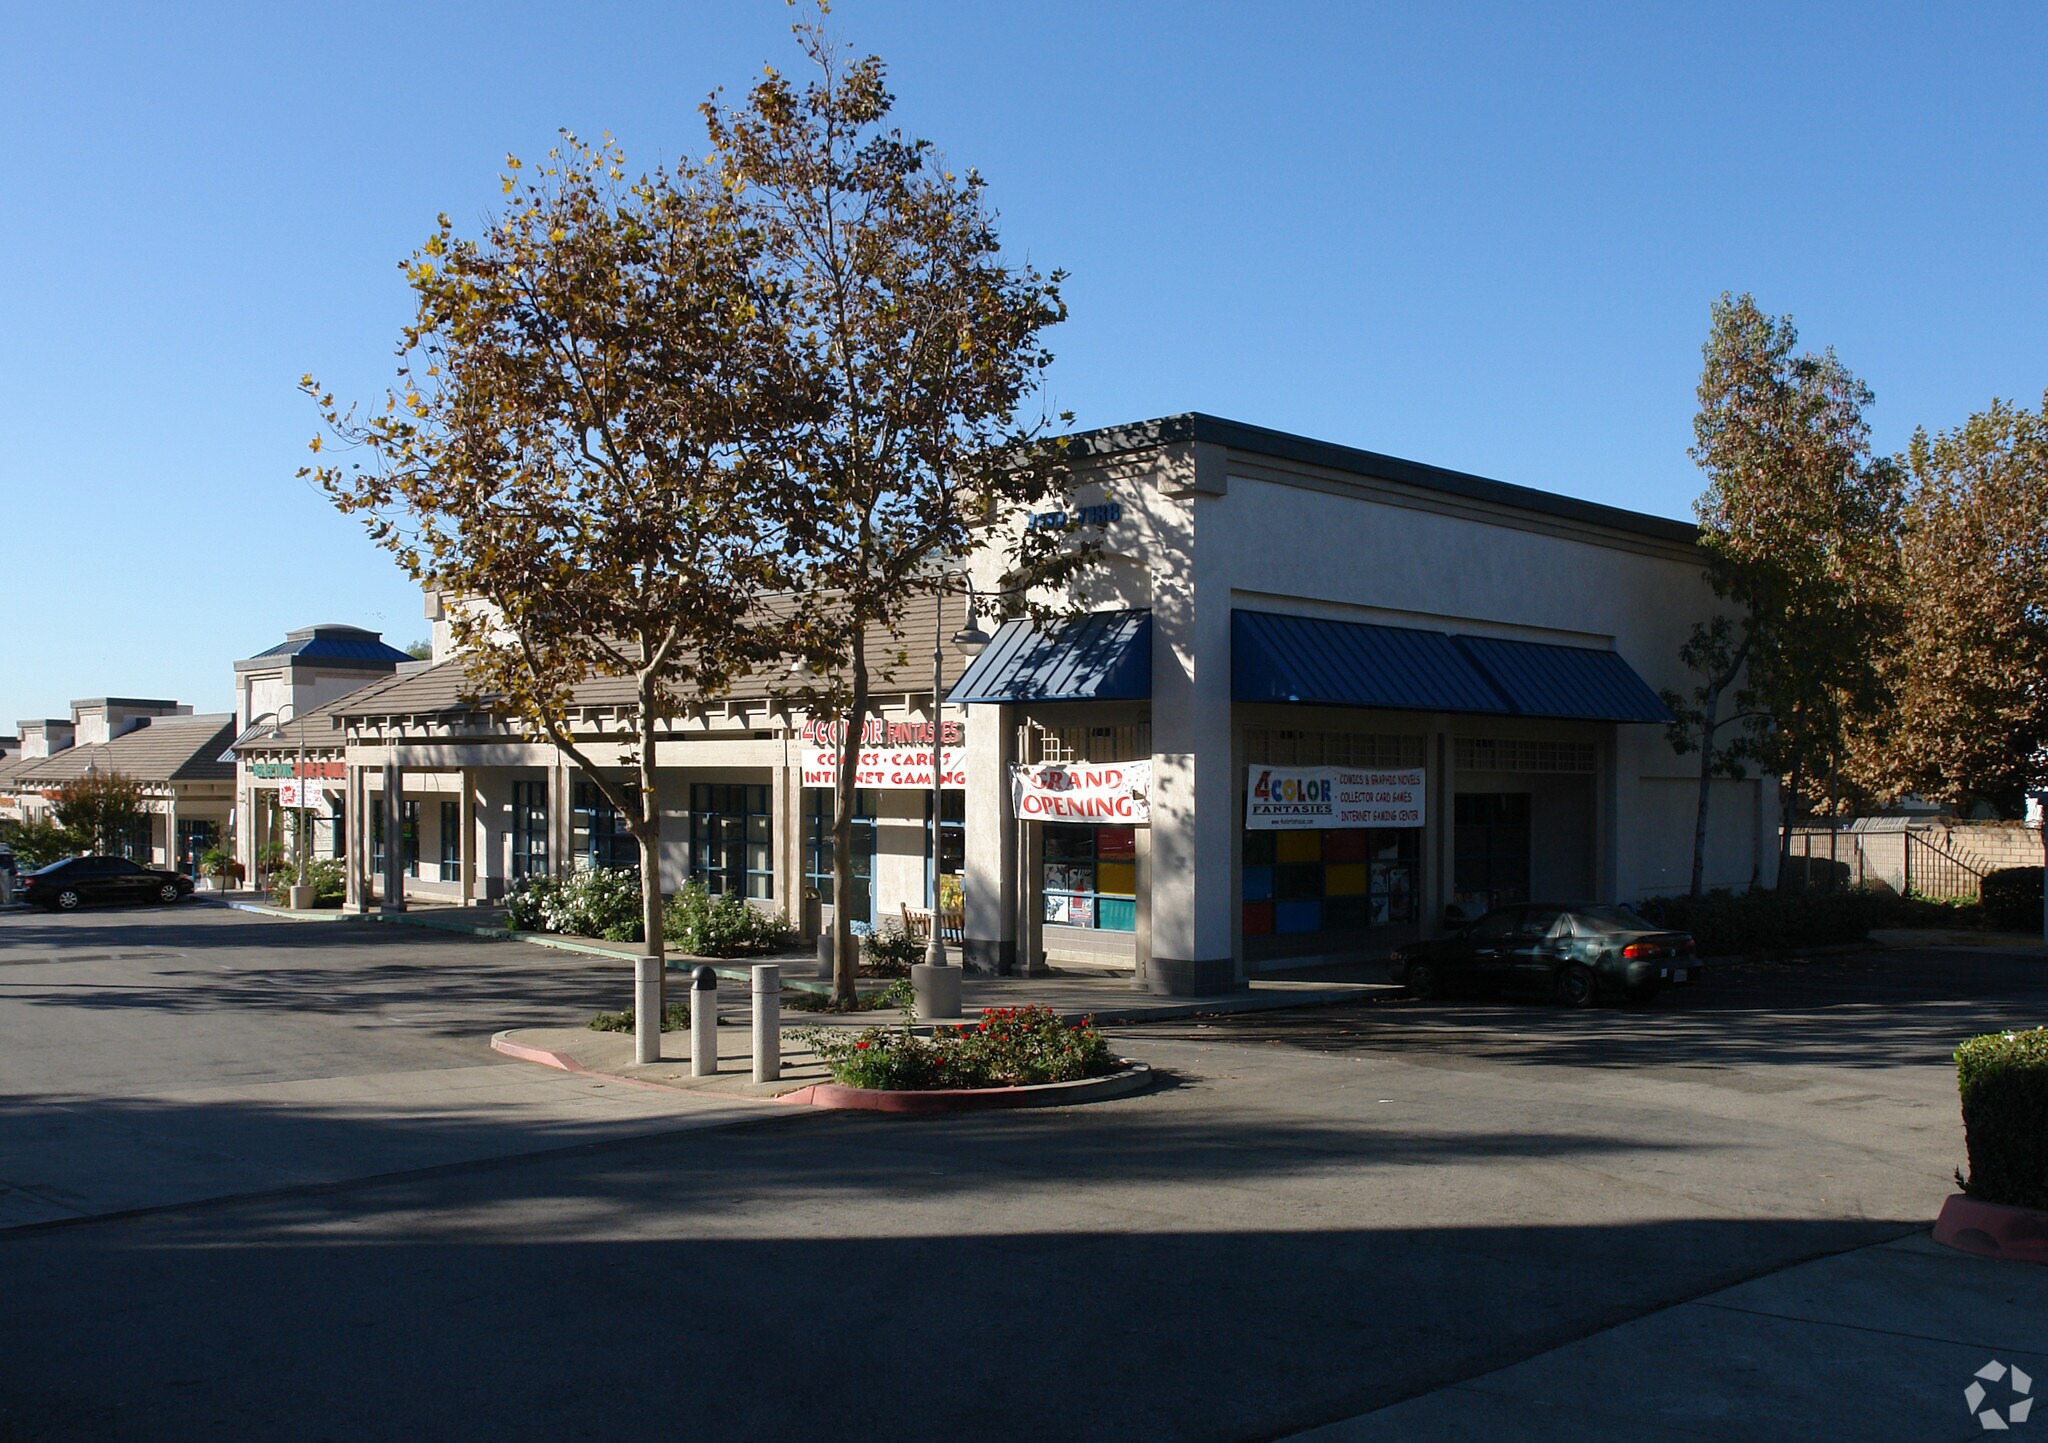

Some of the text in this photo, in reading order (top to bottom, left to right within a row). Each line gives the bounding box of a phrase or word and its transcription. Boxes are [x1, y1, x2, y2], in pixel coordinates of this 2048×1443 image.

[887, 721, 958, 743] FANTASES
[817, 753, 879, 766] COICS
[805, 771, 966, 785] INTNET GAMNG
[1031, 769, 1123, 790] GRAND
[1340, 774, 1364, 785] COMICS
[1371, 774, 1397, 785] GRAPHIC
[1398, 774, 1421, 786] NOVELS
[1340, 791, 1412, 803] COLLECTOR CARD GAMES
[1023, 794, 1132, 817] OPENING
[1253, 805, 1333, 813] FANTASIES
[1341, 809, 1419, 822] INTERNET GAMING CENTER
